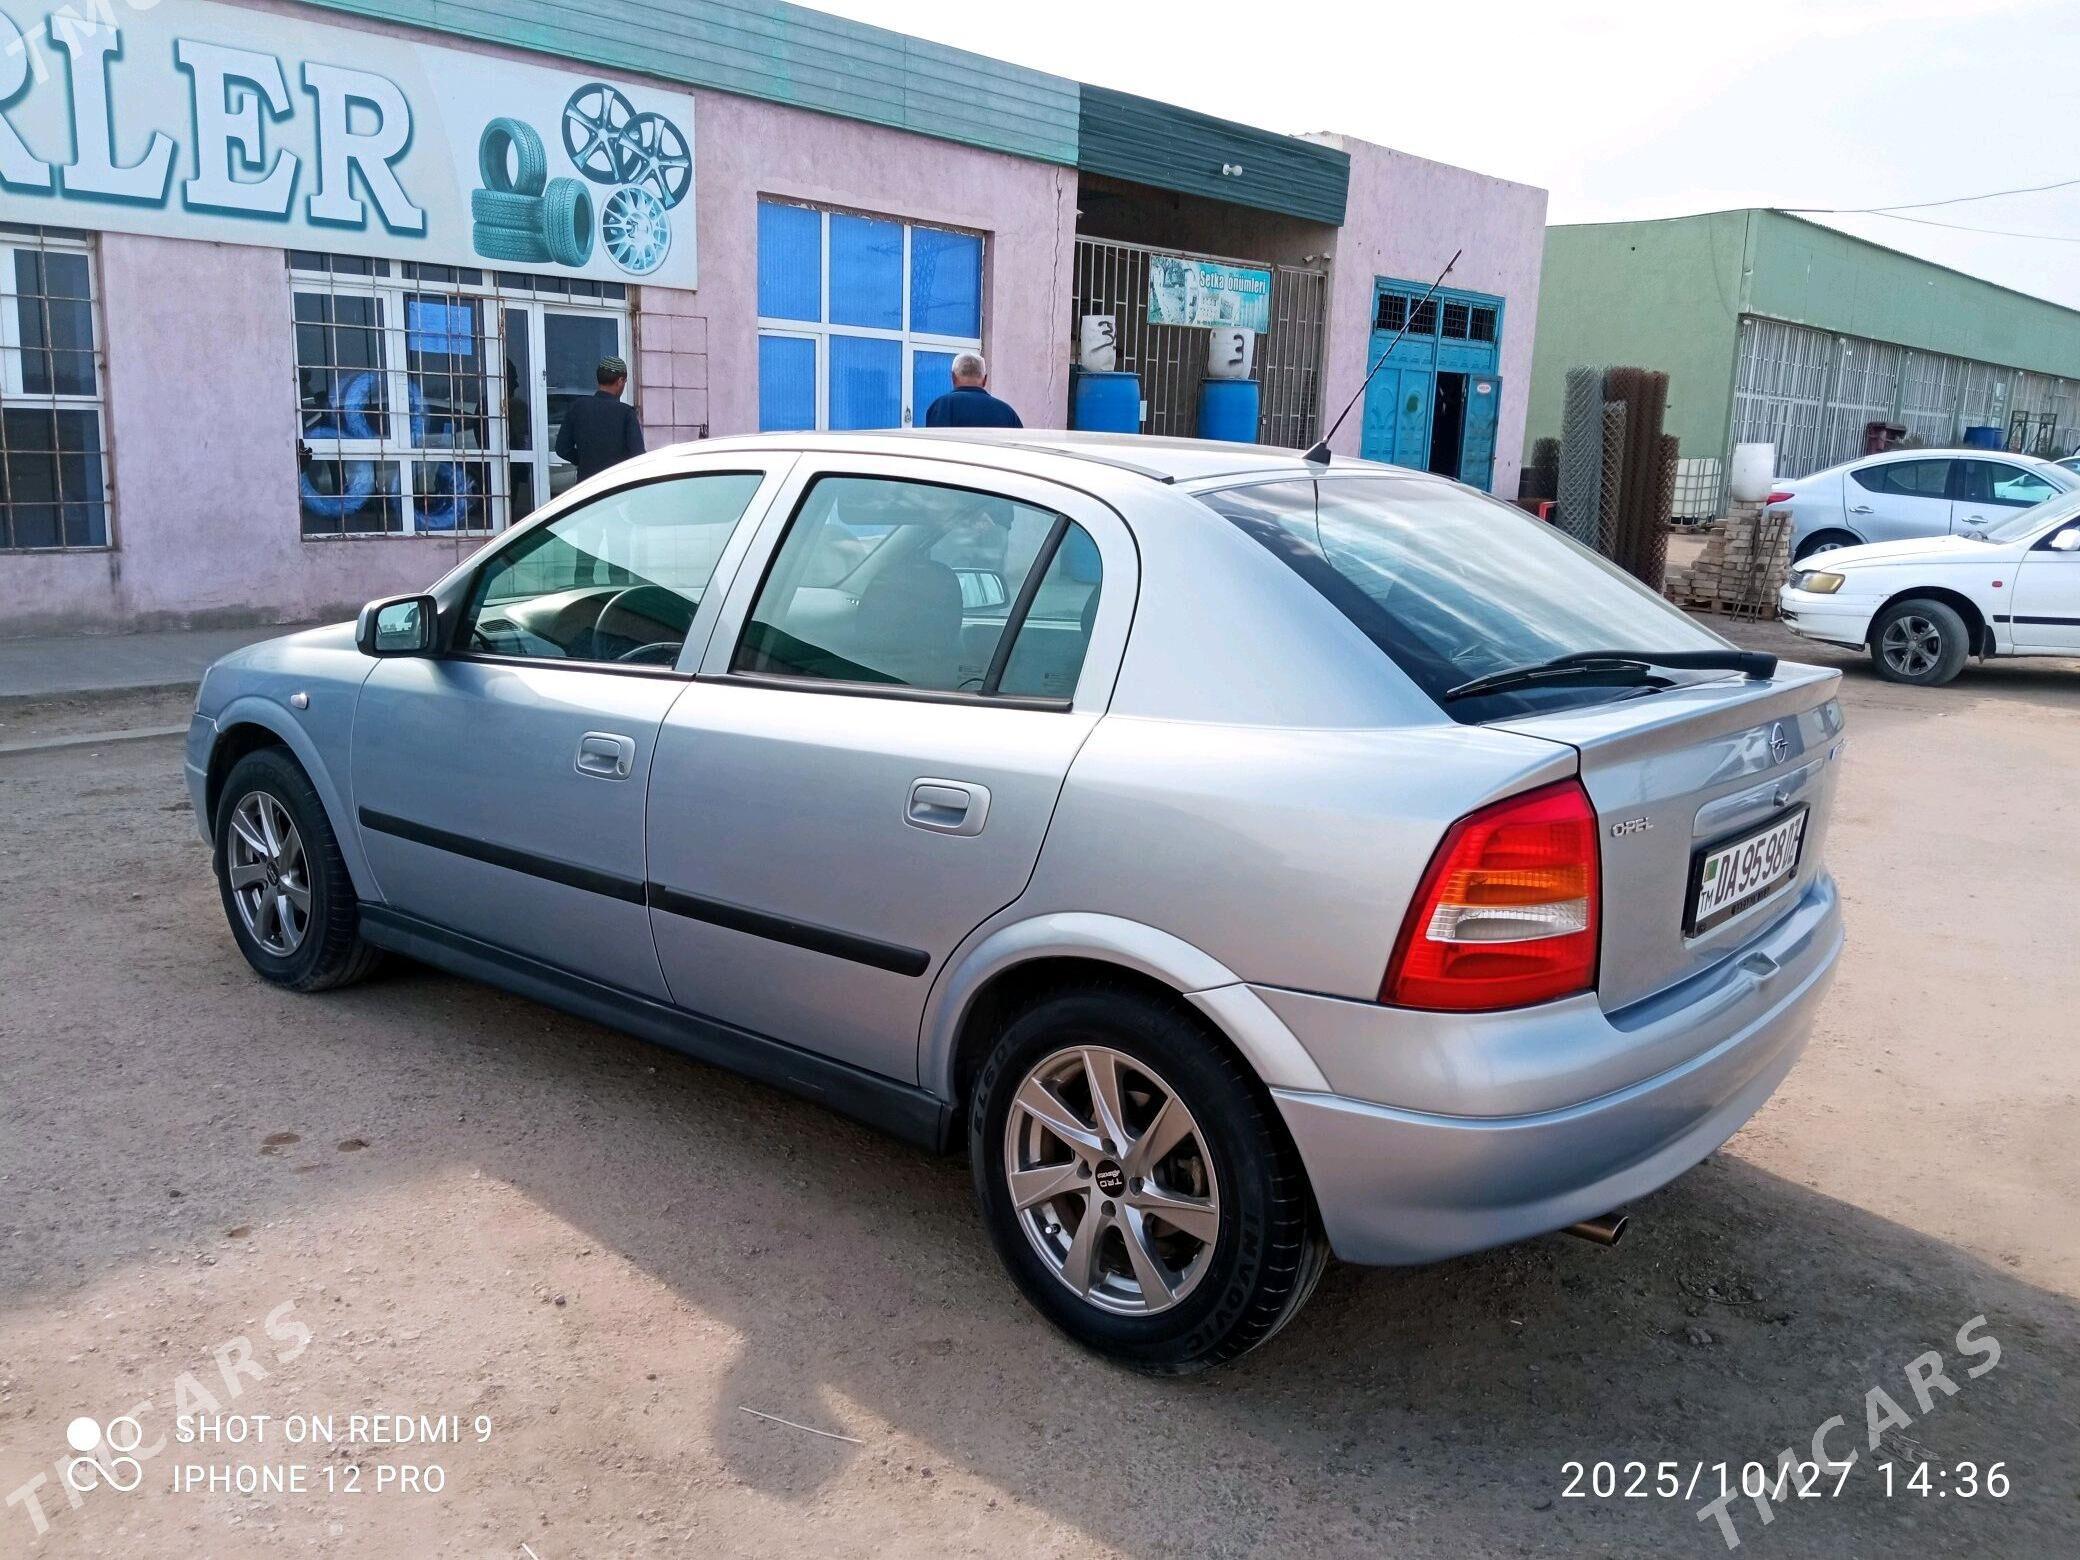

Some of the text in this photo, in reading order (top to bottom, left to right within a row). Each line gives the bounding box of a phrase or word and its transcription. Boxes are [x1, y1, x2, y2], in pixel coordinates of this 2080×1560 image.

[1199, 270, 1266, 295] Setka önümleri
[1090, 321, 1117, 353] 3
[1611, 817, 1654, 838] OPEL
[1700, 888, 1714, 913] TM
[1099, 1178, 1123, 1188] TRD
